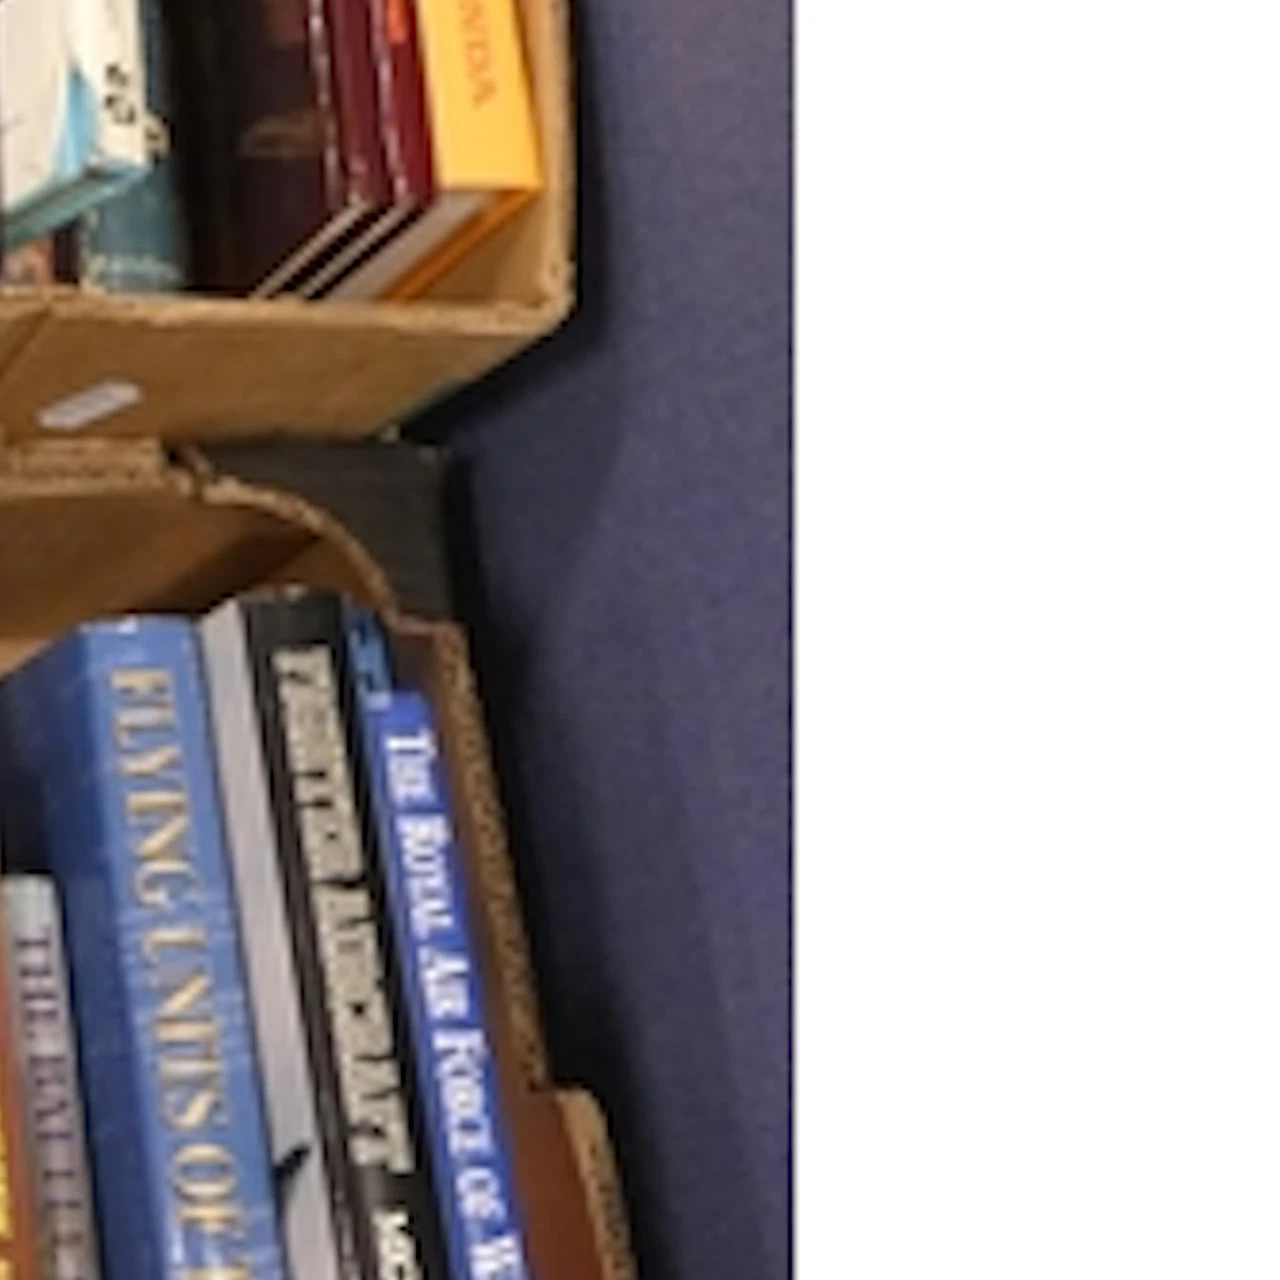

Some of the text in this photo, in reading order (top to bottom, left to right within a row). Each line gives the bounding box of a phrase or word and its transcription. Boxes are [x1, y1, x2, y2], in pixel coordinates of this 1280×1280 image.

[105, 664, 205, 912] FLYING
[381, 725, 445, 809] THE
[269, 641, 418, 1176] FIGHTER AIRCRAFT
[393, 813, 466, 936] ROYAL
[138, 924, 235, 1134] UNITS
[417, 948, 482, 1024] AIR
[429, 1030, 505, 1158] FORCE
[165, 1143, 249, 1243] OF
[452, 1166, 505, 1221] OF
